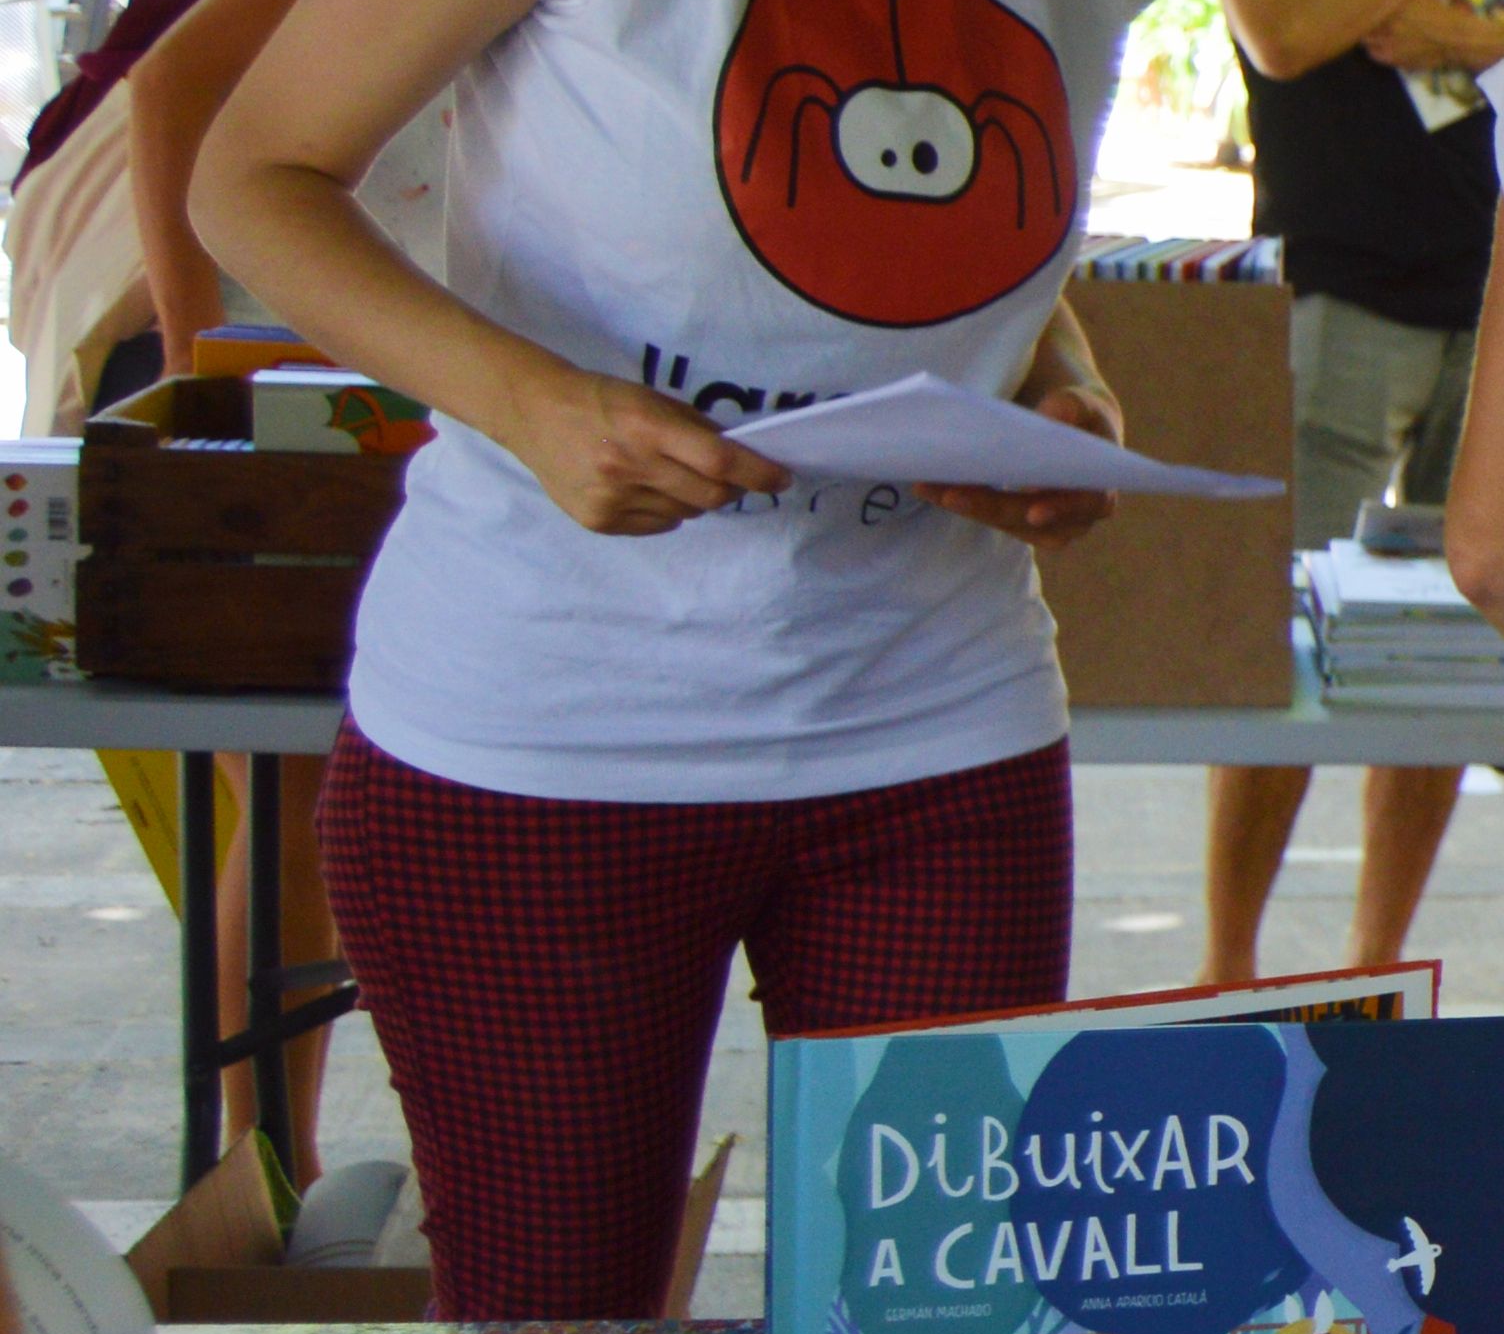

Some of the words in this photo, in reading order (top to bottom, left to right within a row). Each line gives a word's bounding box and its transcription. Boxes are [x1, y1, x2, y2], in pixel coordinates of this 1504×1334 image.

[869, 1238, 905, 1287] A
[935, 1210, 1204, 1289] CAVALL
[936, 1301, 992, 1319] MACHADO
[1081, 1294, 1112, 1310] ANNA
[1116, 1291, 1164, 1309] APARICIO
